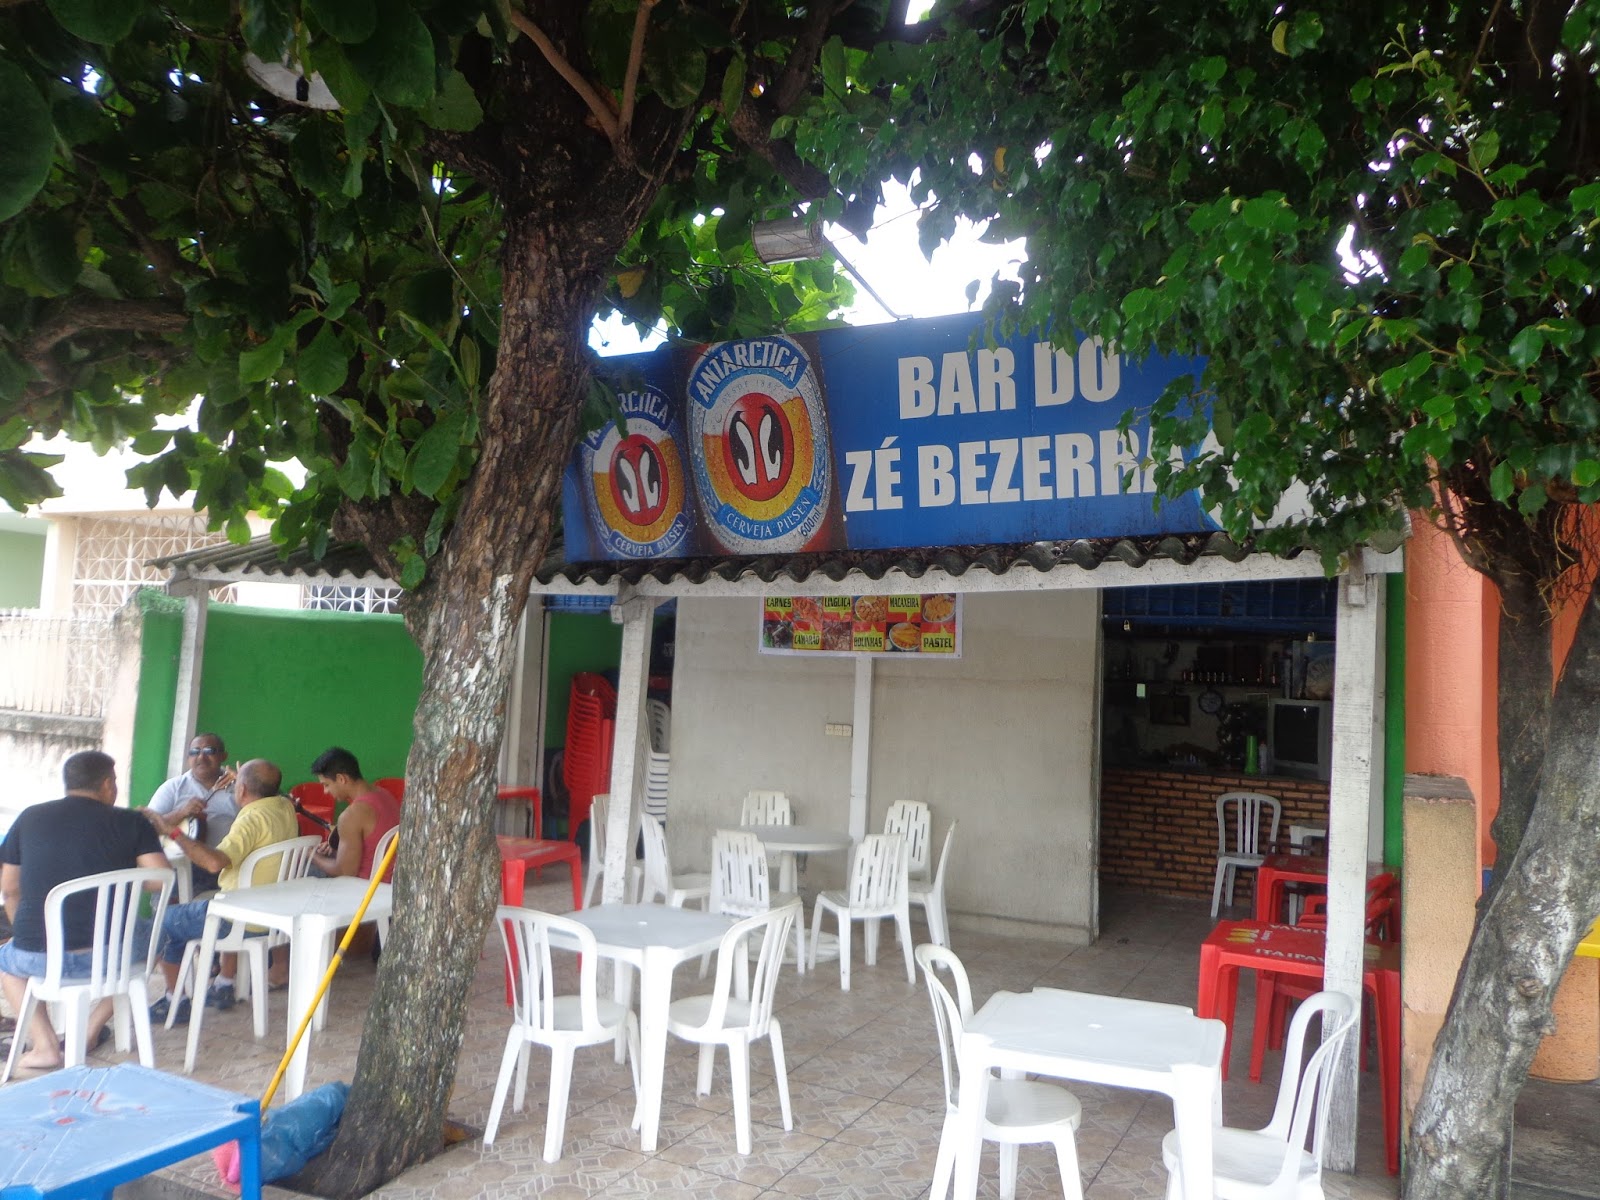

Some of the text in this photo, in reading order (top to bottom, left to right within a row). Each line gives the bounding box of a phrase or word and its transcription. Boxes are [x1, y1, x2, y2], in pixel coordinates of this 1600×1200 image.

[695, 341, 799, 402] ANTARCTICA
[898, 335, 1120, 419] BAR DO
[846, 436, 903, 512] ZÉ
[727, 497, 812, 537] CERVEJA PILSEN
[801, 509, 822, 537] 600ml
[615, 521, 684, 555] CERVEJA PILSEN
[766, 597, 792, 608] CARNES
[889, 598, 919, 608] MACAXEIRA
[794, 632, 820, 645] CAMARÃO
[854, 637, 883, 648] BOLINHAS
[923, 638, 952, 648] PASTEL
[1256, 948, 1324, 961] ITAIPA
